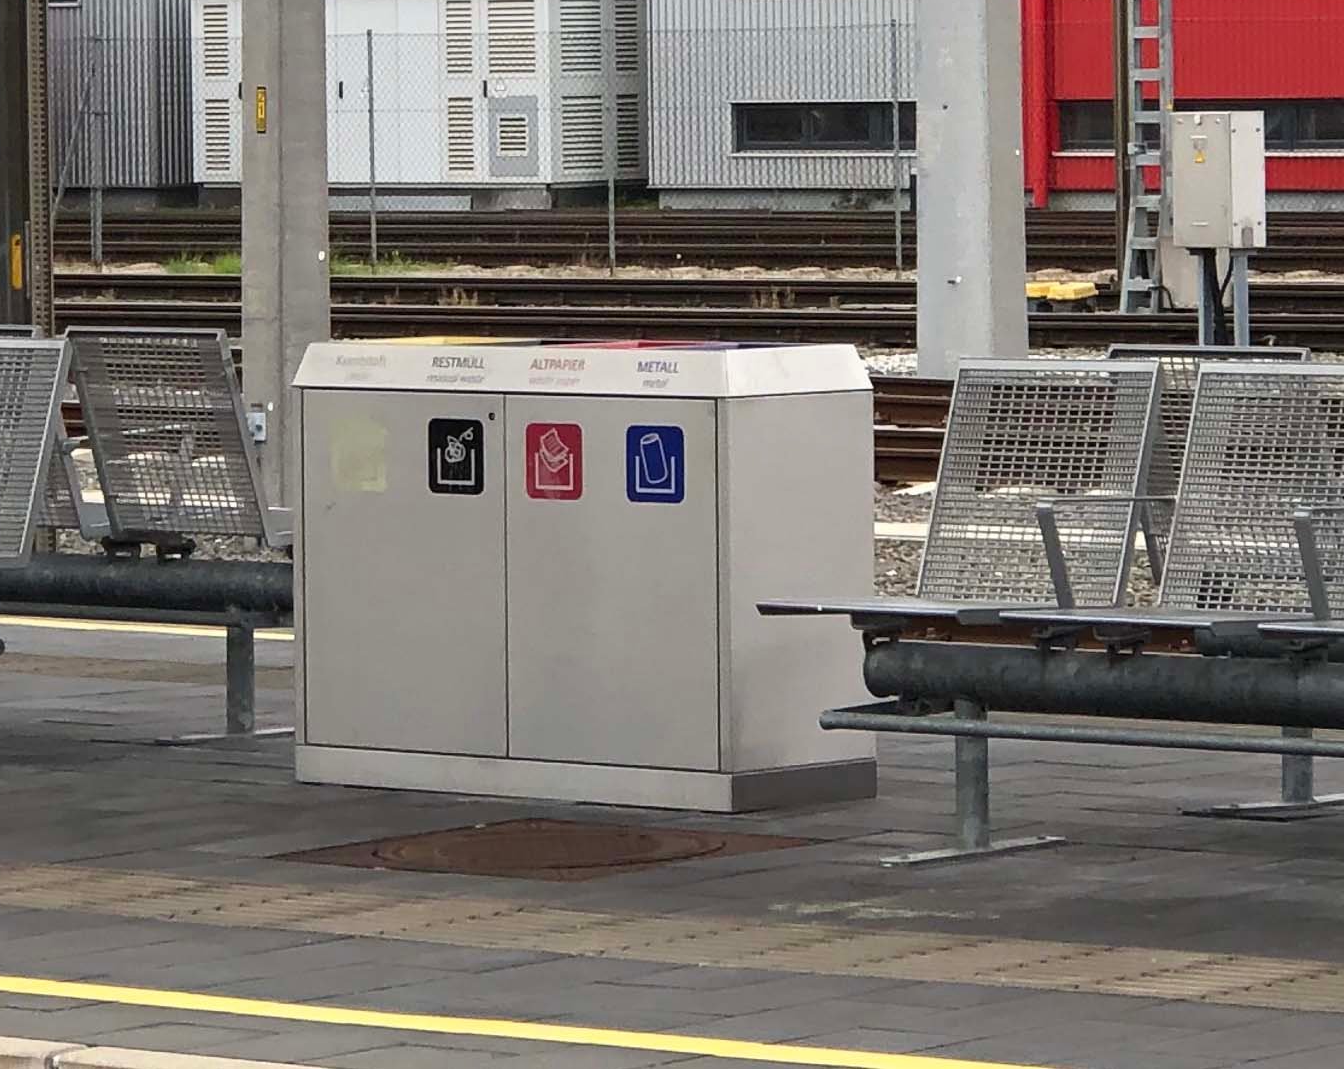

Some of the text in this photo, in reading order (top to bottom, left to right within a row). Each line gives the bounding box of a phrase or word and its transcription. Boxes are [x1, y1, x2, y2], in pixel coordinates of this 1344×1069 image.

[431, 355, 485, 370] RESTMÜLL
[529, 357, 586, 372] ALTPAPIER
[637, 360, 680, 374] METALL
